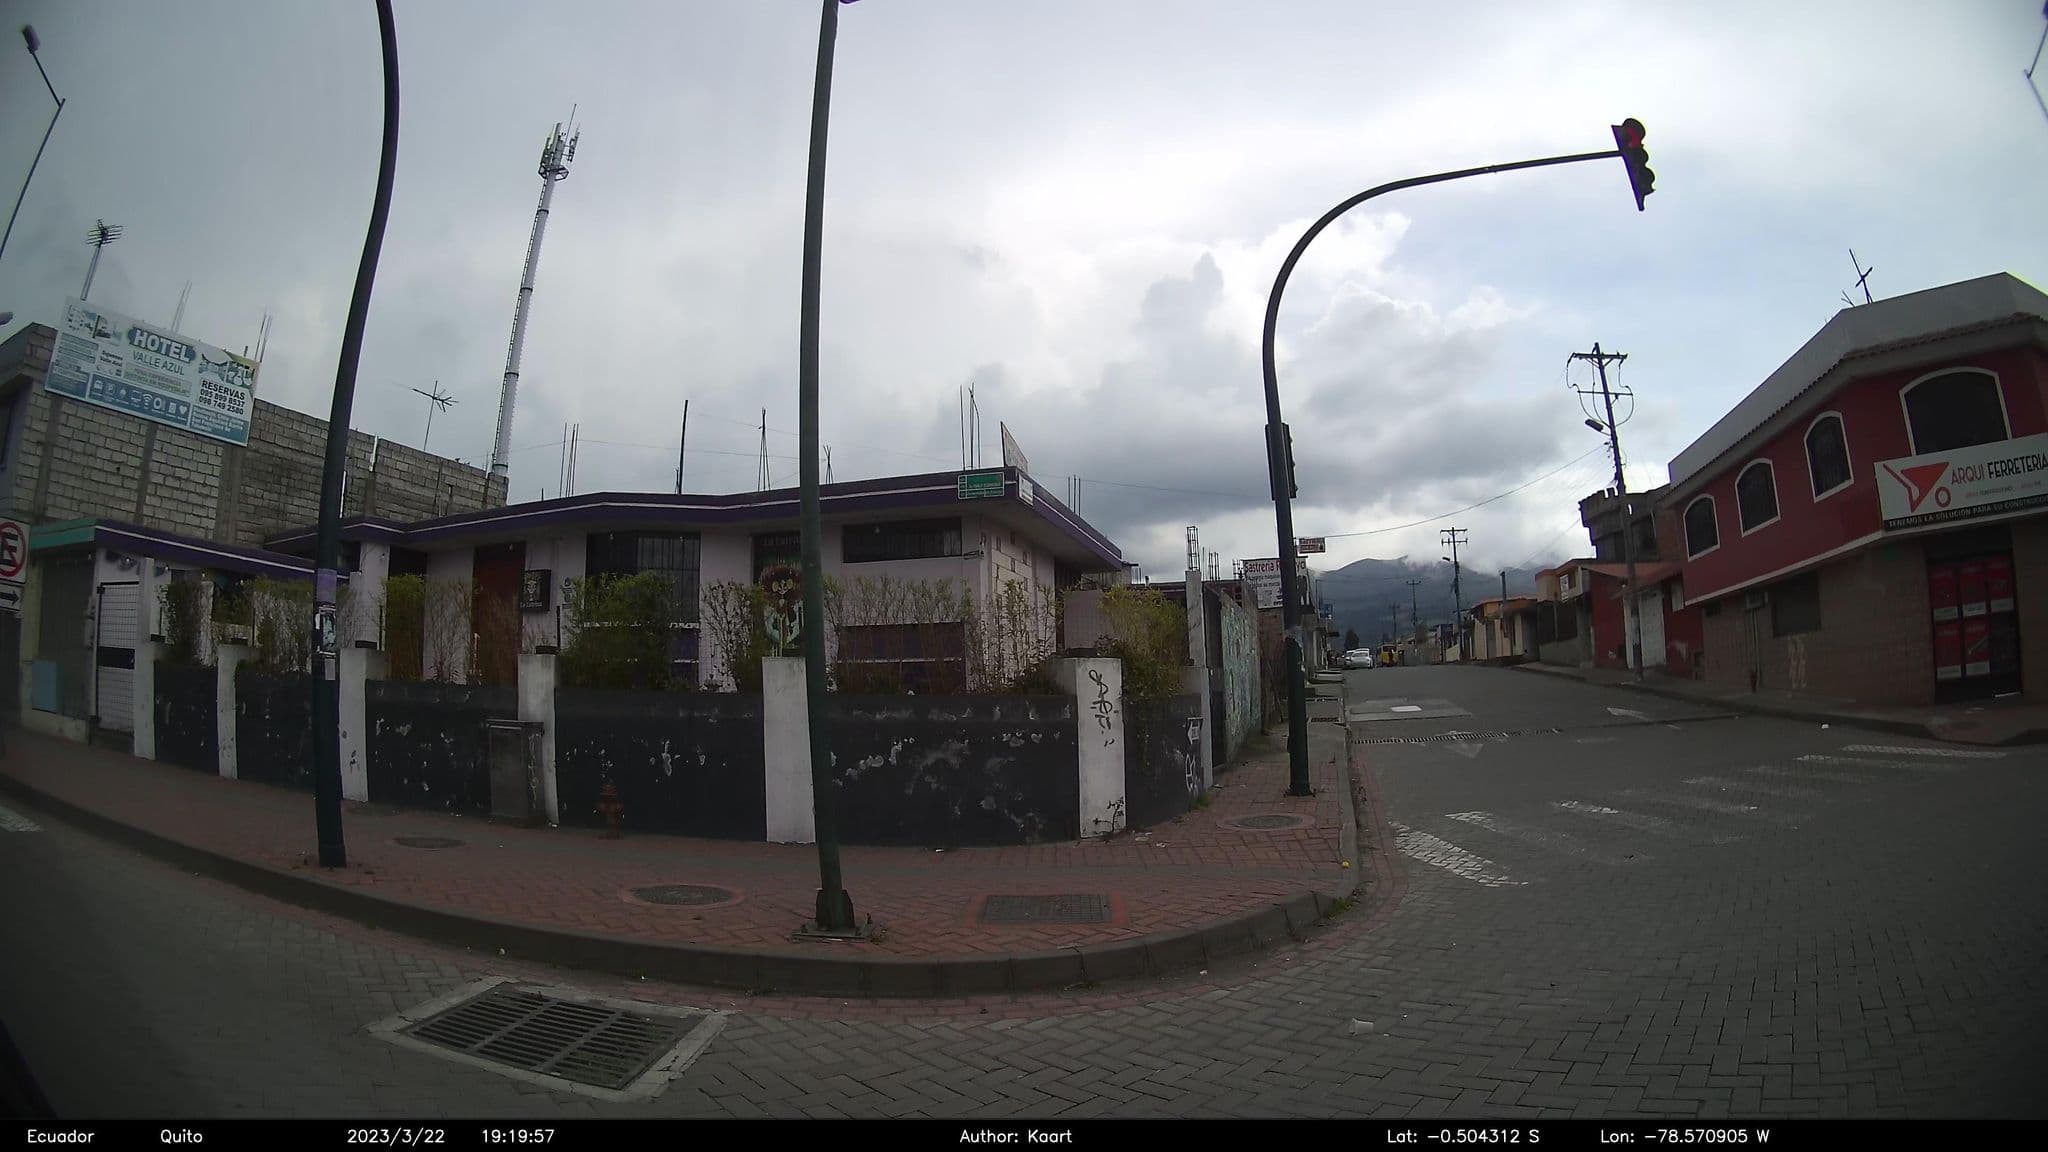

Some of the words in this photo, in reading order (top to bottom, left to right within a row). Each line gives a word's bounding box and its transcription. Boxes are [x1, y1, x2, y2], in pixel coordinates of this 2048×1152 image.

[133, 329, 190, 363] HOTEL
[133, 350, 161, 368] VALLE
[162, 360, 185, 376] AZUL
[201, 380, 245, 401] RESERVAS
[1951, 463, 1985, 486] ARQUI
[1987, 452, 2048, 479] FERRETERIA
[1972, 505, 1991, 516] PARA
